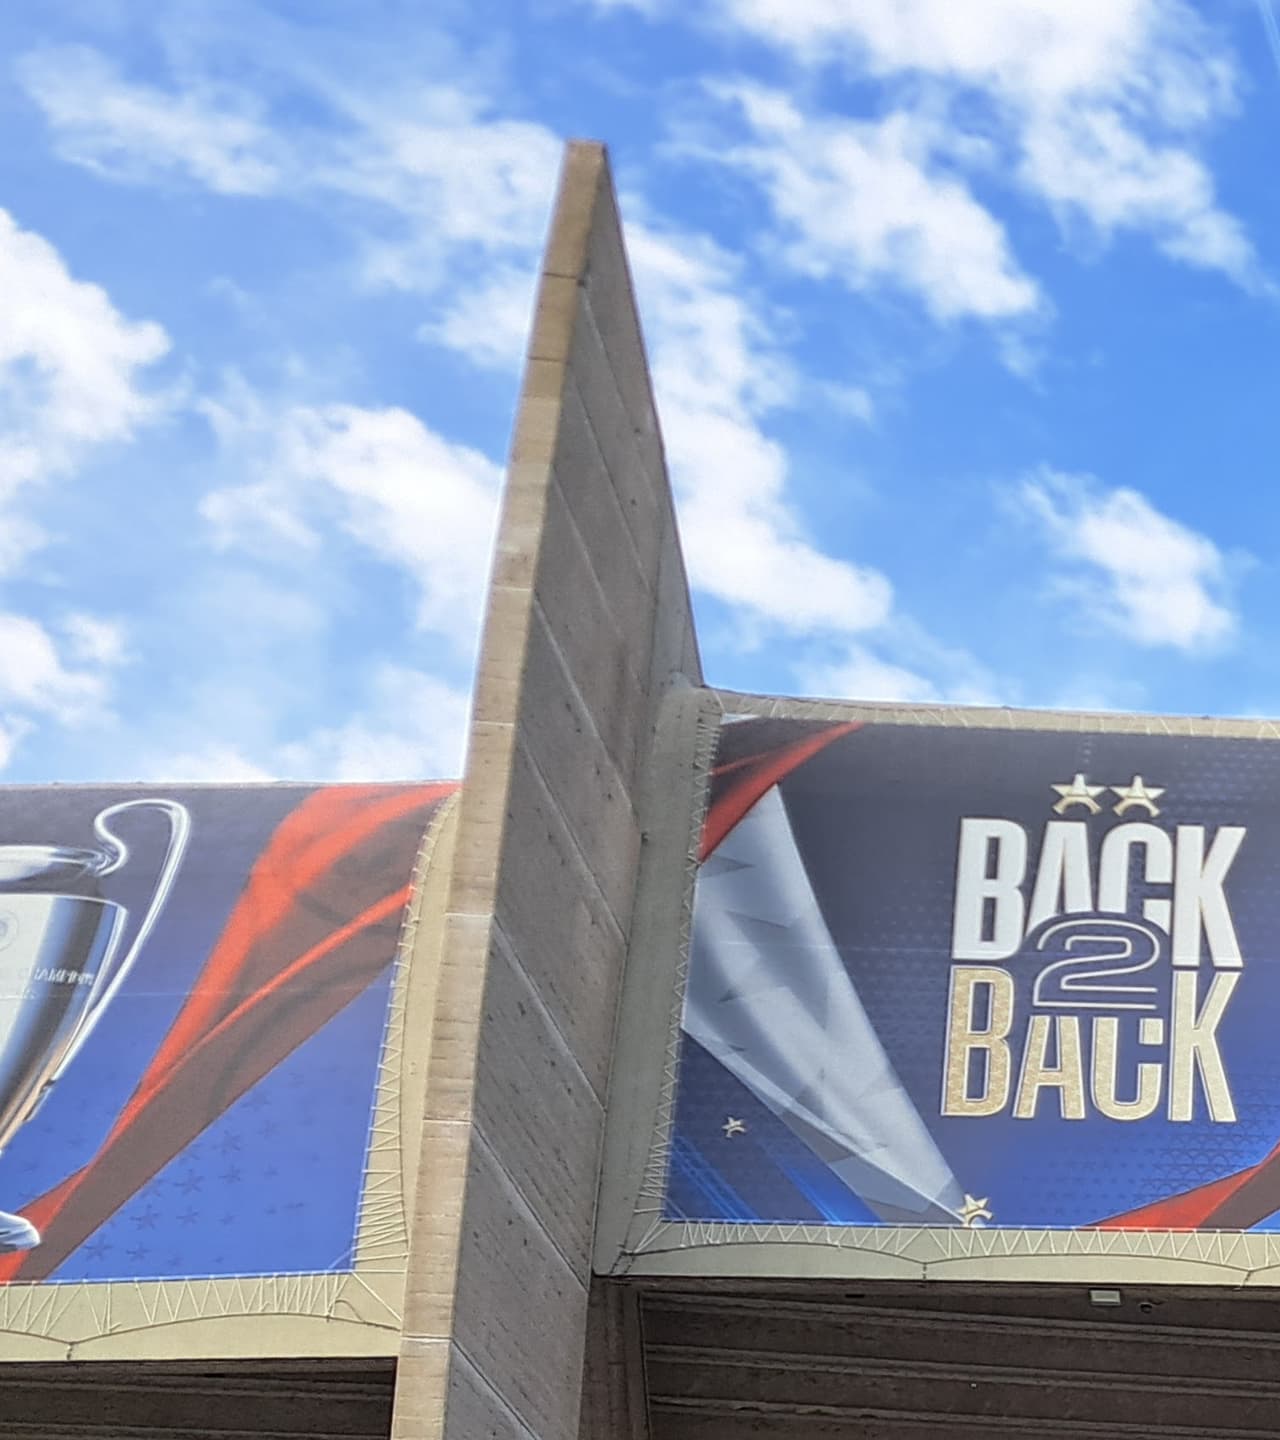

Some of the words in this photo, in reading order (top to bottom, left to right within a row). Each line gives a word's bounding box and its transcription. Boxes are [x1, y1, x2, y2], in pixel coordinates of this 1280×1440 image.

[951, 817, 1247, 968] BACK
[1032, 918, 1161, 1010] 2
[940, 964, 1243, 1123] BACK
